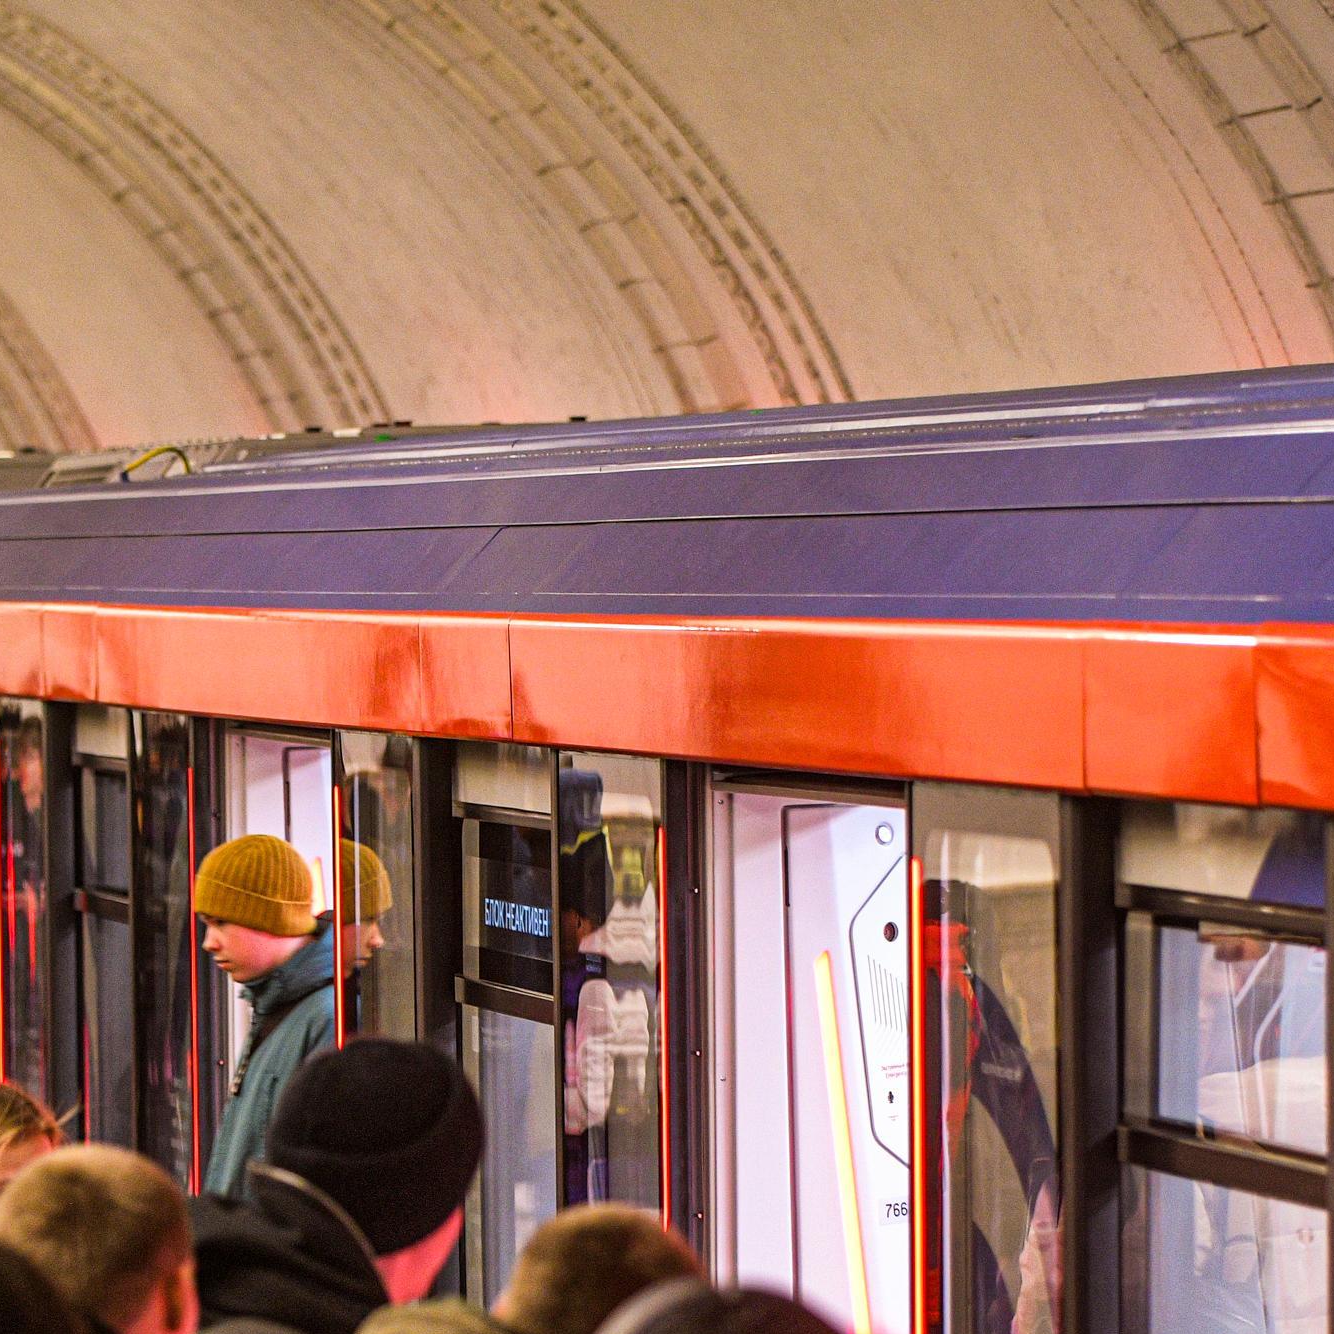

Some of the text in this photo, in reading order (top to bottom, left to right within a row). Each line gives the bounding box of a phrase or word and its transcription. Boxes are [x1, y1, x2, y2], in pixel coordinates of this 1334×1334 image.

[484, 898, 548, 937] БЛОК НЕАКТИВЕН
[885, 1202, 908, 1218] 766
